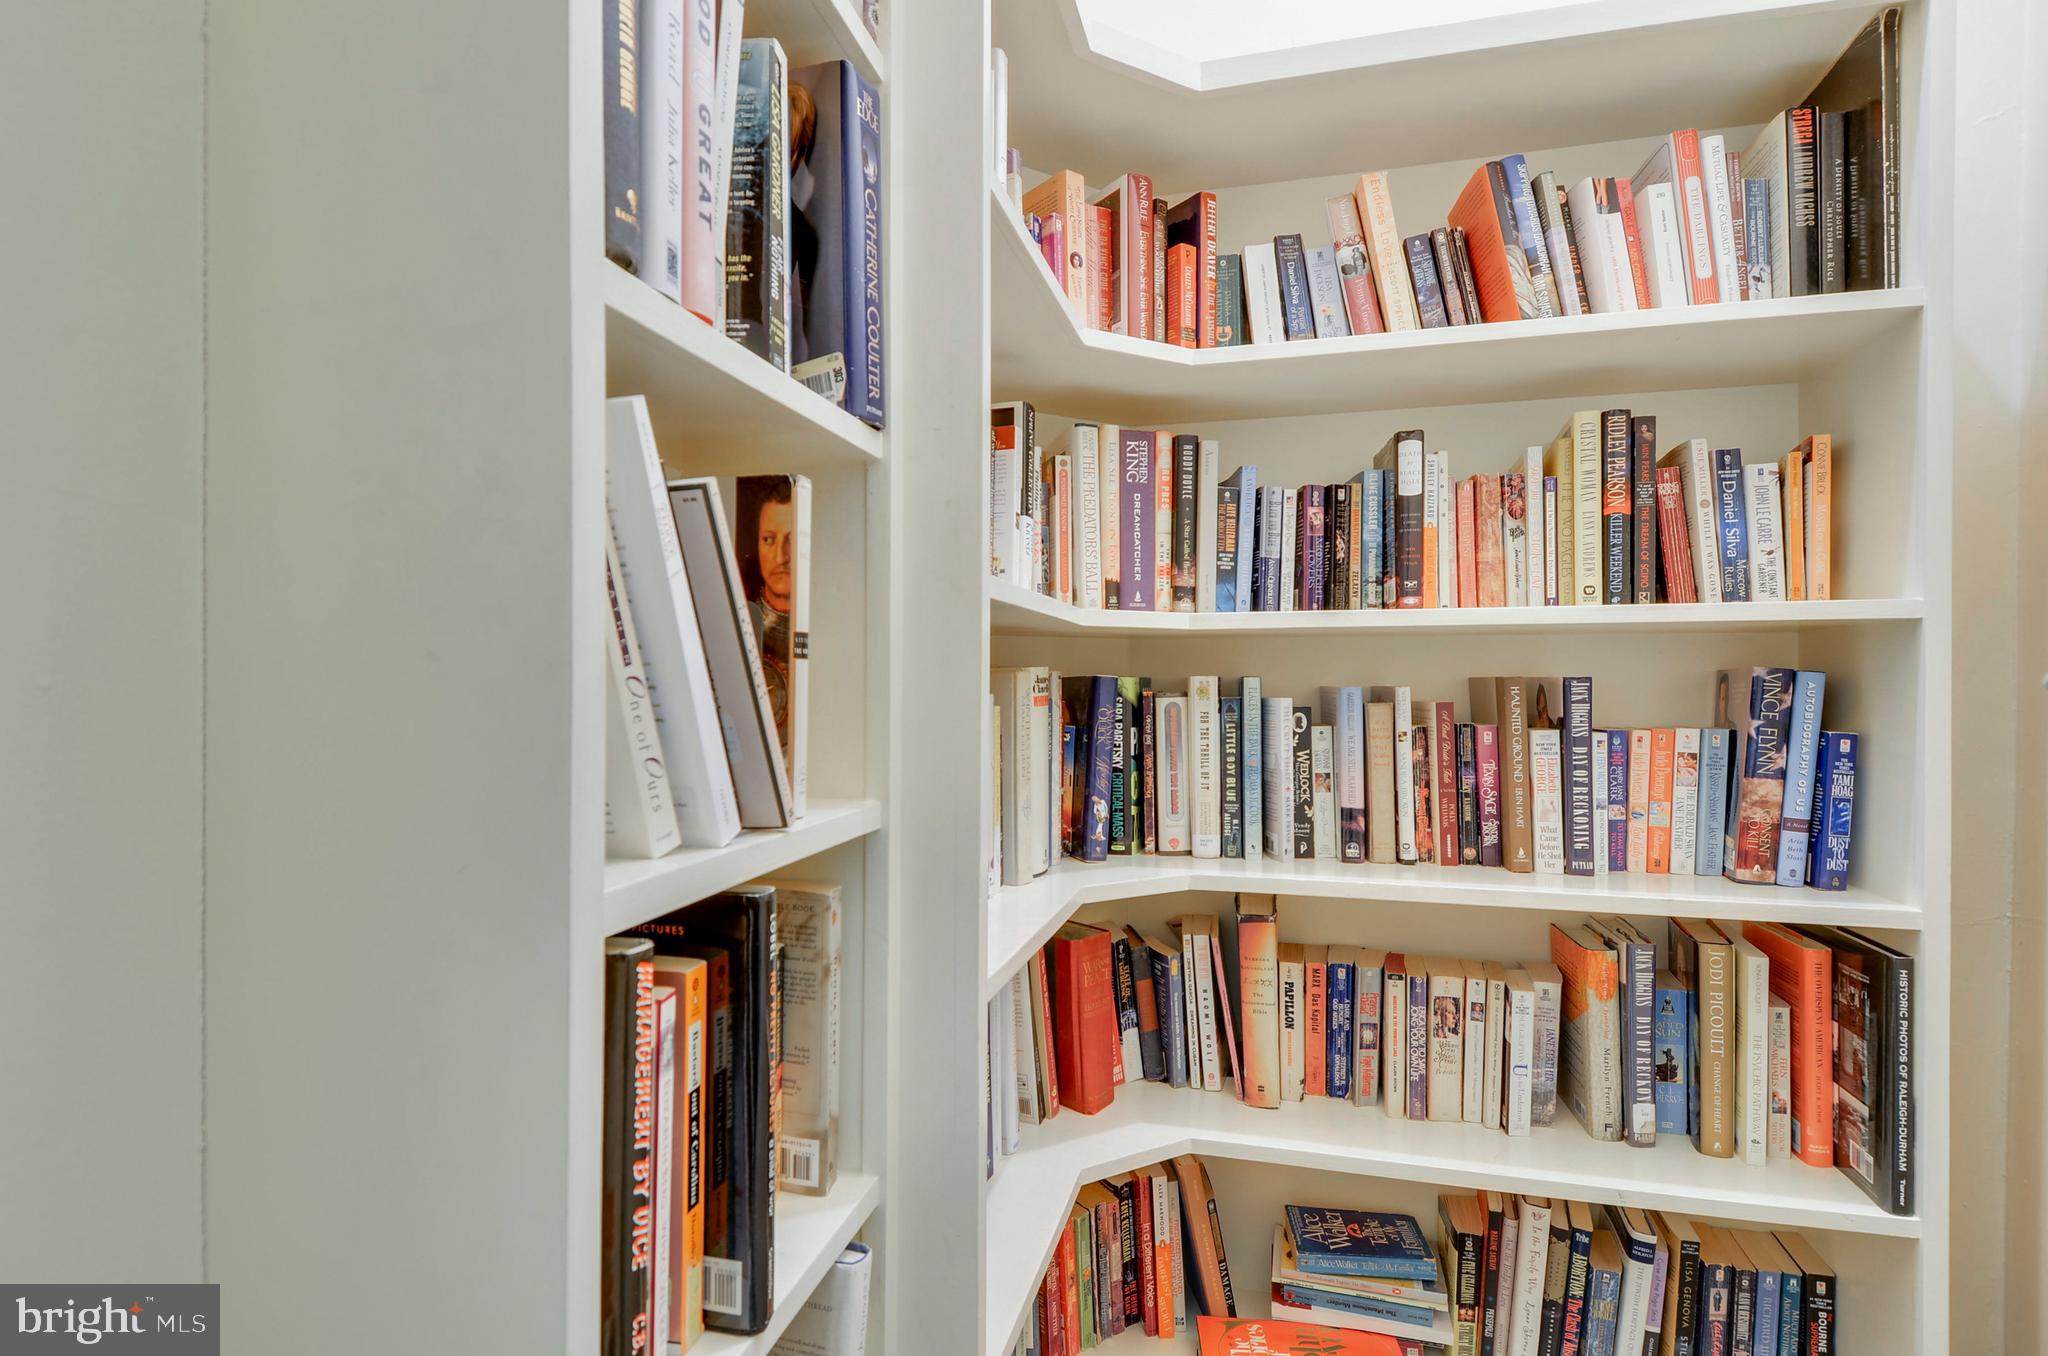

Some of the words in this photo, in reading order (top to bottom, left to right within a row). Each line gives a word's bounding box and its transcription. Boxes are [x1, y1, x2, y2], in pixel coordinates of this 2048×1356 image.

[667, 12, 680, 87] Road
[667, 99, 680, 147] Julia
[770, 84, 783, 132] LISA
[857, 96, 879, 134] EDGE
[1791, 108, 1814, 144] STREGA
[697, 103, 712, 231] GREAT
[770, 133, 783, 220] GARDNER
[1711, 145, 1721, 181] MUTUAL
[1794, 150, 1814, 190] ANDREW
[666, 152, 680, 213] Keller
[1516, 163, 1532, 199] SKIPPING
[1689, 186, 1700, 210] THE
[1715, 182, 1726, 202] LIFE
[1835, 167, 1844, 201] DENSITY
[1207, 199, 1217, 238] JEFFERY
[1524, 199, 1541, 232] TOWARDS
[1794, 192, 1816, 228] VACHSS
[1835, 214, 1843, 240] SOULS
[863, 186, 878, 303] CATHERINE
[1692, 213, 1708, 269] DARLINGS
[1719, 214, 1731, 257] CASUALTY
[1733, 219, 1745, 256] BETTER
[1826, 201, 1835, 260] CHRISTOPHER
[770, 235, 780, 300] NOTHING
[1207, 240, 1217, 278] DEAVER
[1531, 233, 1552, 275] GOMORRAH
[1286, 262, 1297, 286] Daniel
[1531, 274, 1545, 291] DAN
[1736, 256, 1747, 293] ANGEL
[1826, 261, 1835, 282] RICE
[1290, 286, 1300, 305] Silva
[1535, 291, 1553, 321] SAVAGE
[866, 306, 881, 400] COULTER
[1580, 422, 1597, 465] CRYSTAL
[1607, 414, 1626, 454] RIDLEY
[1082, 453, 1094, 480] THE
[1126, 440, 1139, 483] KING
[1138, 440, 1148, 484] STEPHEN
[1183, 444, 1193, 473] RODDY
[1427, 459, 1435, 487] SHIRLEY
[1641, 461, 1649, 481] PEARS
[1026, 450, 1034, 516] COLLECTION
[1183, 474, 1193, 500] DOYLE
[1368, 472, 1378, 495] CLIVE
[1582, 469, 1597, 503] WOMAN
[1606, 457, 1626, 507] PEARSON
[1754, 484, 1770, 506] JOHN
[1368, 495, 1378, 530] CUSSLER
[1427, 489, 1435, 518] HAZZARD
[1641, 506, 1649, 522] THE
[1722, 480, 1738, 523] Daniel
[1755, 506, 1770, 516] LE
[1083, 481, 1097, 560] PREDATORS'
[1133, 493, 1142, 581] DREAMCATCHER
[1561, 508, 1573, 536] TWO
[1610, 513, 1623, 545] KILLER
[1641, 523, 1649, 550] DREAM
[1703, 511, 1712, 541] WHILE
[1561, 540, 1573, 578] EAGLES
[1641, 551, 1649, 561] OF
[1725, 527, 1740, 558] Silva
[1307, 549, 1316, 589] LOVERS
[1582, 542, 1596, 578] ANDREWS
[1610, 547, 1623, 593] WEEKEND
[1641, 563, 1649, 588] SCIPIO
[1706, 552, 1714, 570] WAS
[1766, 557, 1776, 567] THE
[1085, 562, 1098, 596] BALL
[1351, 570, 1360, 599] ZELAZNY
[1707, 573, 1717, 598] GONE
[1724, 566, 1735, 593] Rules
[1736, 559, 1747, 598] Moscow
[1757, 562, 1768, 594] GARDENER
[1767, 568, 1779, 598] CONSTANT
[626, 676, 646, 723] One
[1570, 680, 1590, 702] JACK
[1760, 672, 1783, 720] VINCE
[1200, 711, 1209, 726] FOR
[1509, 686, 1523, 735] HAUNTED
[1571, 703, 1590, 737] HIGGINS
[637, 732, 653, 752] of
[1112, 722, 1123, 769] PARETSKY
[1200, 727, 1209, 741] THE
[1226, 723, 1236, 754] LITTLE
[1798, 681, 1817, 776] AUTOBIOGRAPHY
[1200, 743, 1209, 769] THRILL
[1226, 756, 1236, 776] BOY
[1512, 736, 1524, 783] GROUND
[1572, 746, 1588, 767] DAY
[1756, 727, 1780, 774] FLYNN
[644, 757, 664, 814] Ours
[1226, 777, 1237, 802] BLUE
[1296, 749, 1311, 803] WEDLOCK
[1482, 760, 1496, 788] TEXAS!
[1535, 757, 1548, 794] GEORGE
[1547, 757, 1560, 794] Elizabeth
[1573, 769, 1588, 784] OF
[1609, 765, 1619, 801] CLARK
[1796, 780, 1807, 795] OF
[1831, 785, 1855, 797] HOAG
[1832, 774, 1855, 786] TAMI
[1112, 772, 1124, 811] CRITICAL
[1480, 789, 1497, 815] SAGE
[1515, 787, 1525, 805] ERIN
[1795, 797, 1806, 813] US
[1112, 812, 1124, 838] MASS
[1441, 797, 1450, 828] WILLIAMS
[1515, 806, 1525, 828] HART
[1573, 786, 1590, 850] RECKONING
[1746, 828, 1760, 850] KILL
[1759, 808, 1772, 858] CONSENT
[1828, 837, 1851, 849] DUST
[1826, 858, 1849, 872] DUST
[1634, 948, 1654, 972] JACK
[1707, 948, 1723, 985] JODI
[1814, 962, 1823, 977] THE
[1311, 968, 1321, 988] MARX
[1635, 972, 1654, 1007] HIGGINS
[1899, 969, 1909, 1018] HISTORIC
[1202, 988, 1211, 1026] NAOMI
[1284, 980, 1295, 1030] PAPILLON
[1311, 993, 1321, 1007] Das
[1814, 979, 1823, 1026] OVERSPENT
[1310, 1008, 1321, 1035] Kapital
[1635, 1016, 1652, 1037] DAY
[1709, 991, 1725, 1058] PICOULT
[633, 961, 653, 1150] MANAGEMENT
[1205, 1034, 1214, 1063] WOLF
[1636, 1040, 1653, 1054] OF
[1814, 1027, 1824, 1070] AMERICAN
[1899, 1020, 1909, 1064] PHOTOS
[1602, 1047, 1612, 1083] Marilyn
[1712, 1061, 1722, 1096] CHANGE
[1771, 1048, 1780, 1087] MICHAELS
[1899, 1065, 1909, 1080] OF
[688, 1091, 699, 1118] out
[1604, 1086, 1613, 1117] French
[1713, 1096, 1722, 1106] OF
[688, 1121, 699, 1138] of
[1713, 1106, 1722, 1134] HEART
[1898, 1080, 1908, 1172] RALEIGH-DURHAM
[632, 1157, 650, 1197] BY
[688, 1141, 700, 1206] Carolina
[1121, 1200, 1131, 1220] FAYE
[632, 1206, 649, 1271] VICE
[1121, 1222, 1133, 1262] KELLERMAN
[1301, 1212, 1324, 1244] Alice
[1322, 1210, 1352, 1252] Walker
[1143, 1241, 1155, 1281] Different
[1569, 1252, 1588, 1298] ABORTION:
[1684, 1261, 1693, 1282] LISA
[1146, 1282, 1155, 1308] Voice
[1219, 1261, 1233, 1307] DAMAGE
[1568, 1298, 1583, 1311] The
[1681, 1286, 1692, 1328] GENOVA
[1760, 1296, 1773, 1343] RICHARD
[1484, 1308, 1495, 1338] PERSEPOLIS
[1565, 1312, 1581, 1332] Clash
[1817, 1311, 1827, 1353] BOURNE
